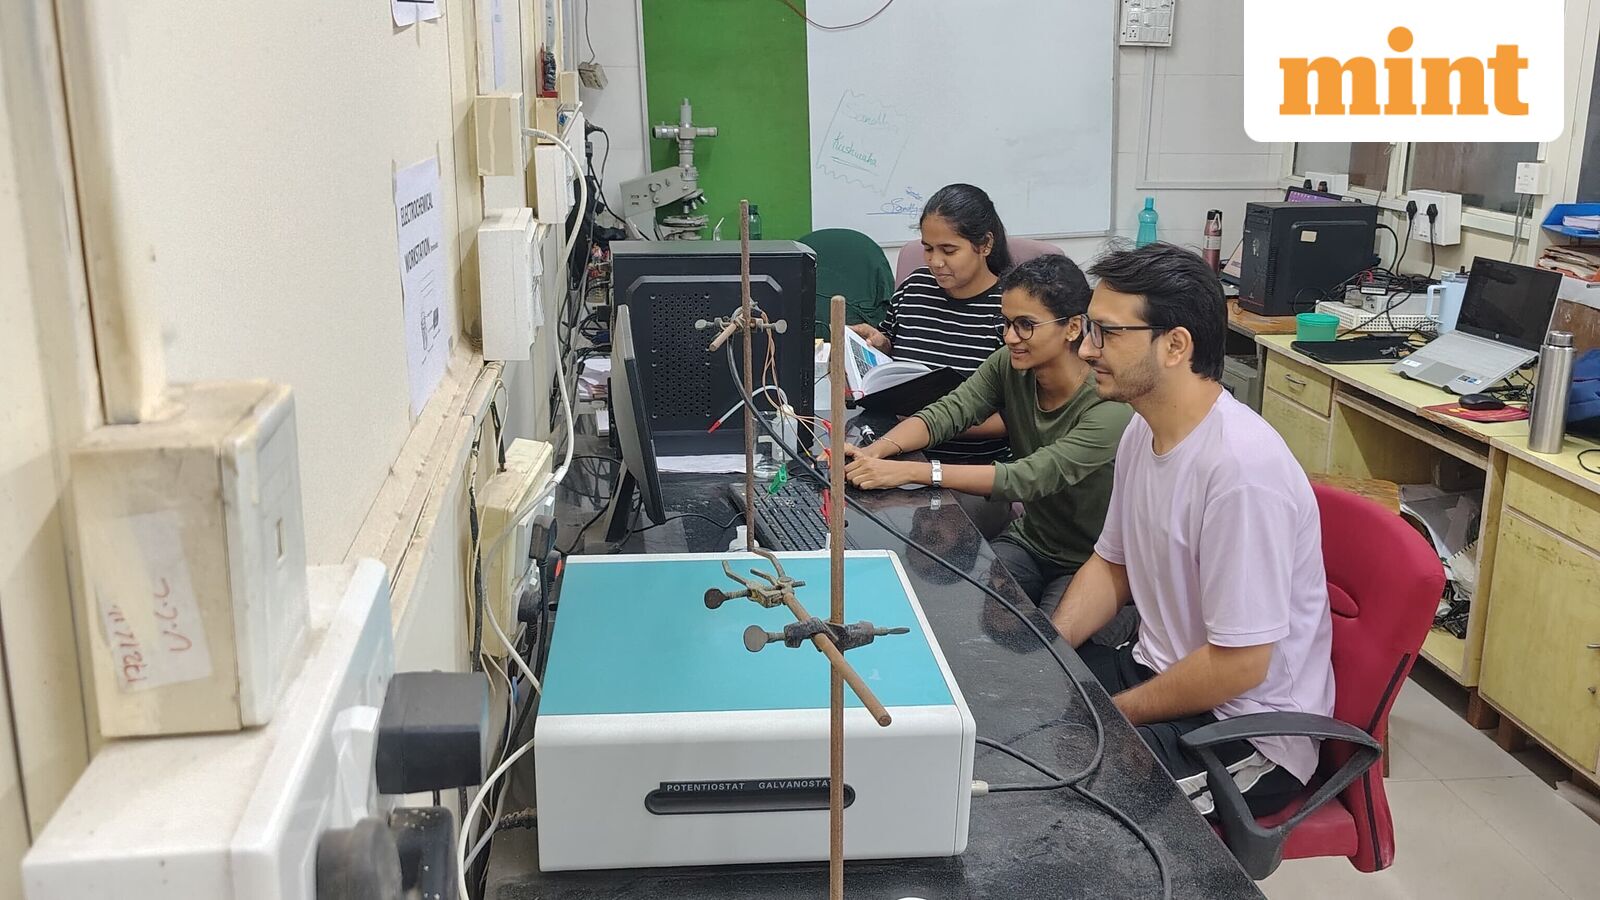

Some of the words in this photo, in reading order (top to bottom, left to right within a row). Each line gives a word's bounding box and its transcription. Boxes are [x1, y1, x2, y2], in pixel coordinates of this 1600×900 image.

[400, 191, 433, 228] ELECTROCHEMICAL
[404, 236, 430, 274] WORKSTATION
[666, 782, 745, 792] POTENTIOSTAT
